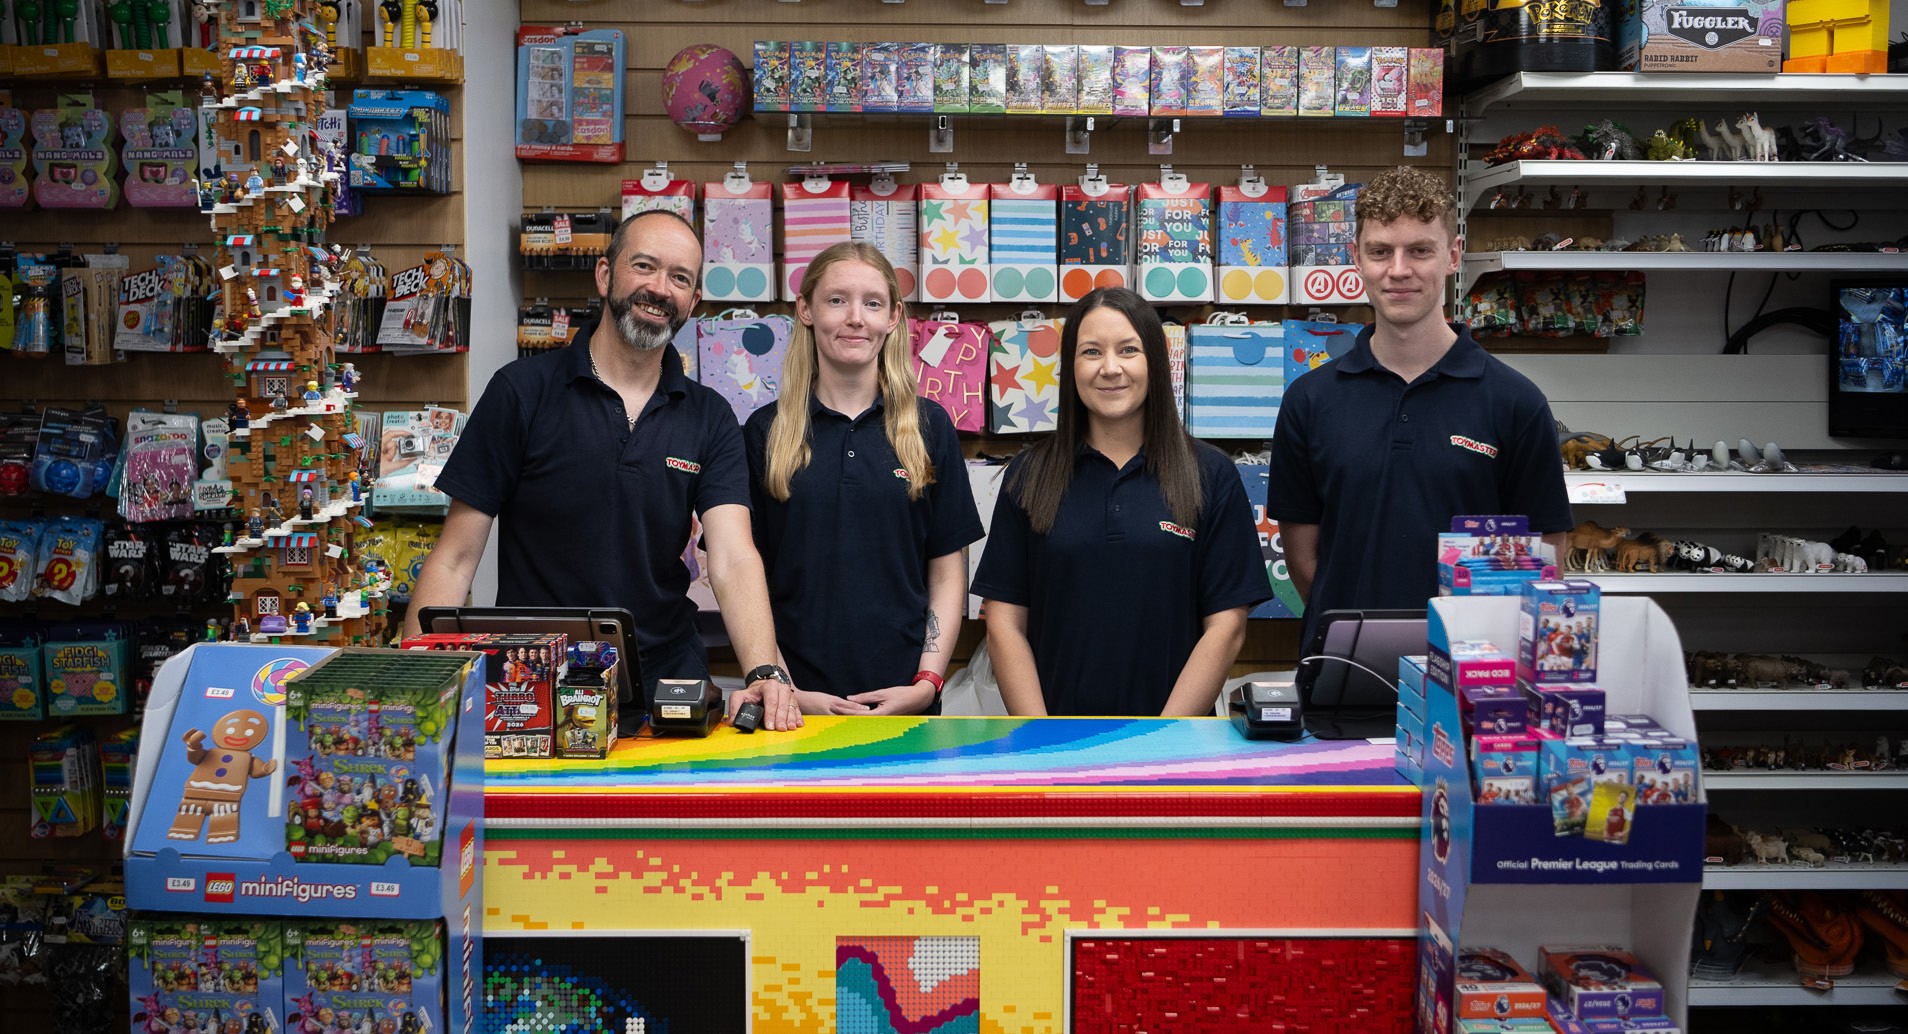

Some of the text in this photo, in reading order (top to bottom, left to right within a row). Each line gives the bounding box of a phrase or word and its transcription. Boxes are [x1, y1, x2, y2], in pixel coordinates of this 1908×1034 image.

[1671, 11, 1754, 32] FUGGLER
[524, 36, 556, 44] casdon
[577, 126, 608, 135] casdon
[1161, 198, 1194, 207] JUST
[1142, 208, 1154, 216] OR
[1165, 210, 1191, 220] FOR
[1142, 217, 1155, 225] OU
[1164, 222, 1192, 233] YOU
[1142, 242, 1159, 252] OR
[1168, 240, 1188, 248] FOR
[1168, 249, 1188, 257] YOU
[124, 270, 164, 302] TECH DECK
[392, 266, 429, 298] TECH DECK
[64, 278, 81, 297] TECH DECK
[134, 432, 188, 444] snazaroo
[1452, 436, 1498, 457] TOYMASTER
[1, 538, 20, 547] TOY
[57, 538, 76, 548] TOY
[109, 540, 147, 558] STAR WARS
[169, 542, 208, 563] STAR WARS
[64, 646, 98, 657] FIDGI
[53, 656, 111, 669] STARFISH
[1465, 669, 1511, 679] ECO PACK
[288, 690, 302, 698] 6+
[495, 691, 535, 703] TURBO
[560, 694, 603, 706] BRAINROT
[333, 758, 388, 775] SHREK
[1497, 857, 1679, 872] Official Premier League Trading Cards
[171, 878, 191, 888] £3.49
[206, 874, 356, 902] LEGO minifigures
[376, 883, 395, 893] £3.49
[132, 928, 145, 937] 6+
[287, 928, 299, 938] 6+
